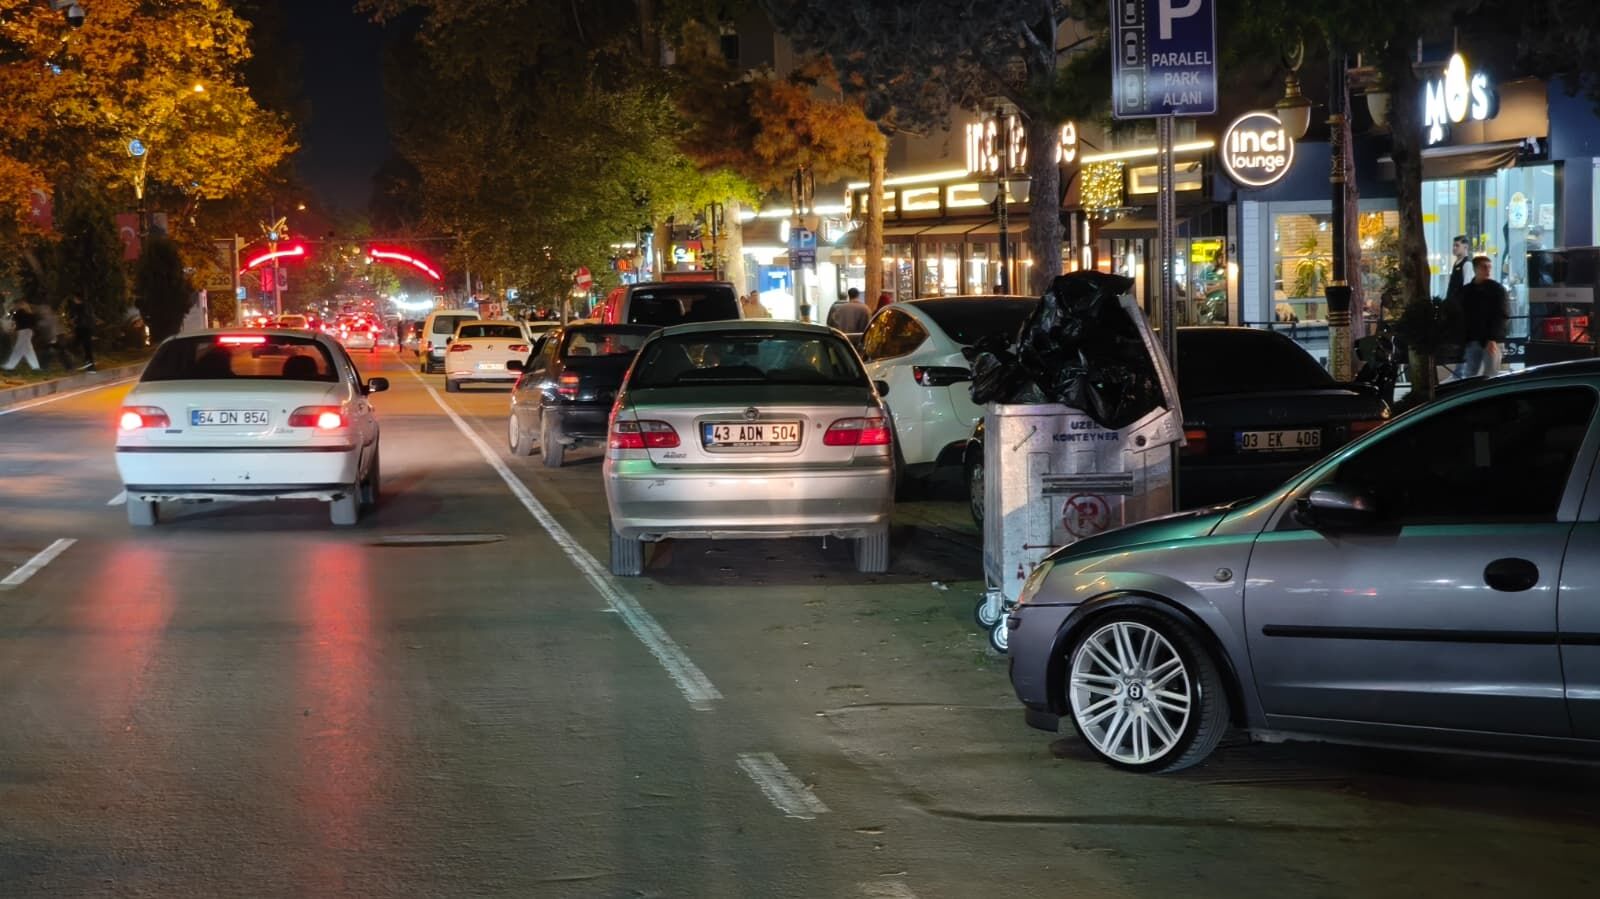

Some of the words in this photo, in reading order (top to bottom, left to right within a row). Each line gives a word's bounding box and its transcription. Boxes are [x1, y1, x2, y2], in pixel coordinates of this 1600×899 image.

[1159, 0, 1202, 40] P
[1151, 51, 1212, 67] PARALEL
[1164, 71, 1200, 87] PARK
[1162, 91, 1202, 106] ALANI
[1231, 153, 1286, 173] lounge
[199, 411, 214, 424] 64
[220, 411, 238, 424] DN
[244, 411, 266, 424] 854
[714, 426, 730, 441] 43
[739, 426, 764, 441] ADN
[772, 425, 797, 441] 504
[1053, 432, 1120, 442] KONTEYNER
[1243, 433, 1258, 448] 03
[1268, 432, 1283, 447] EK
[1296, 431, 1319, 446] 406
